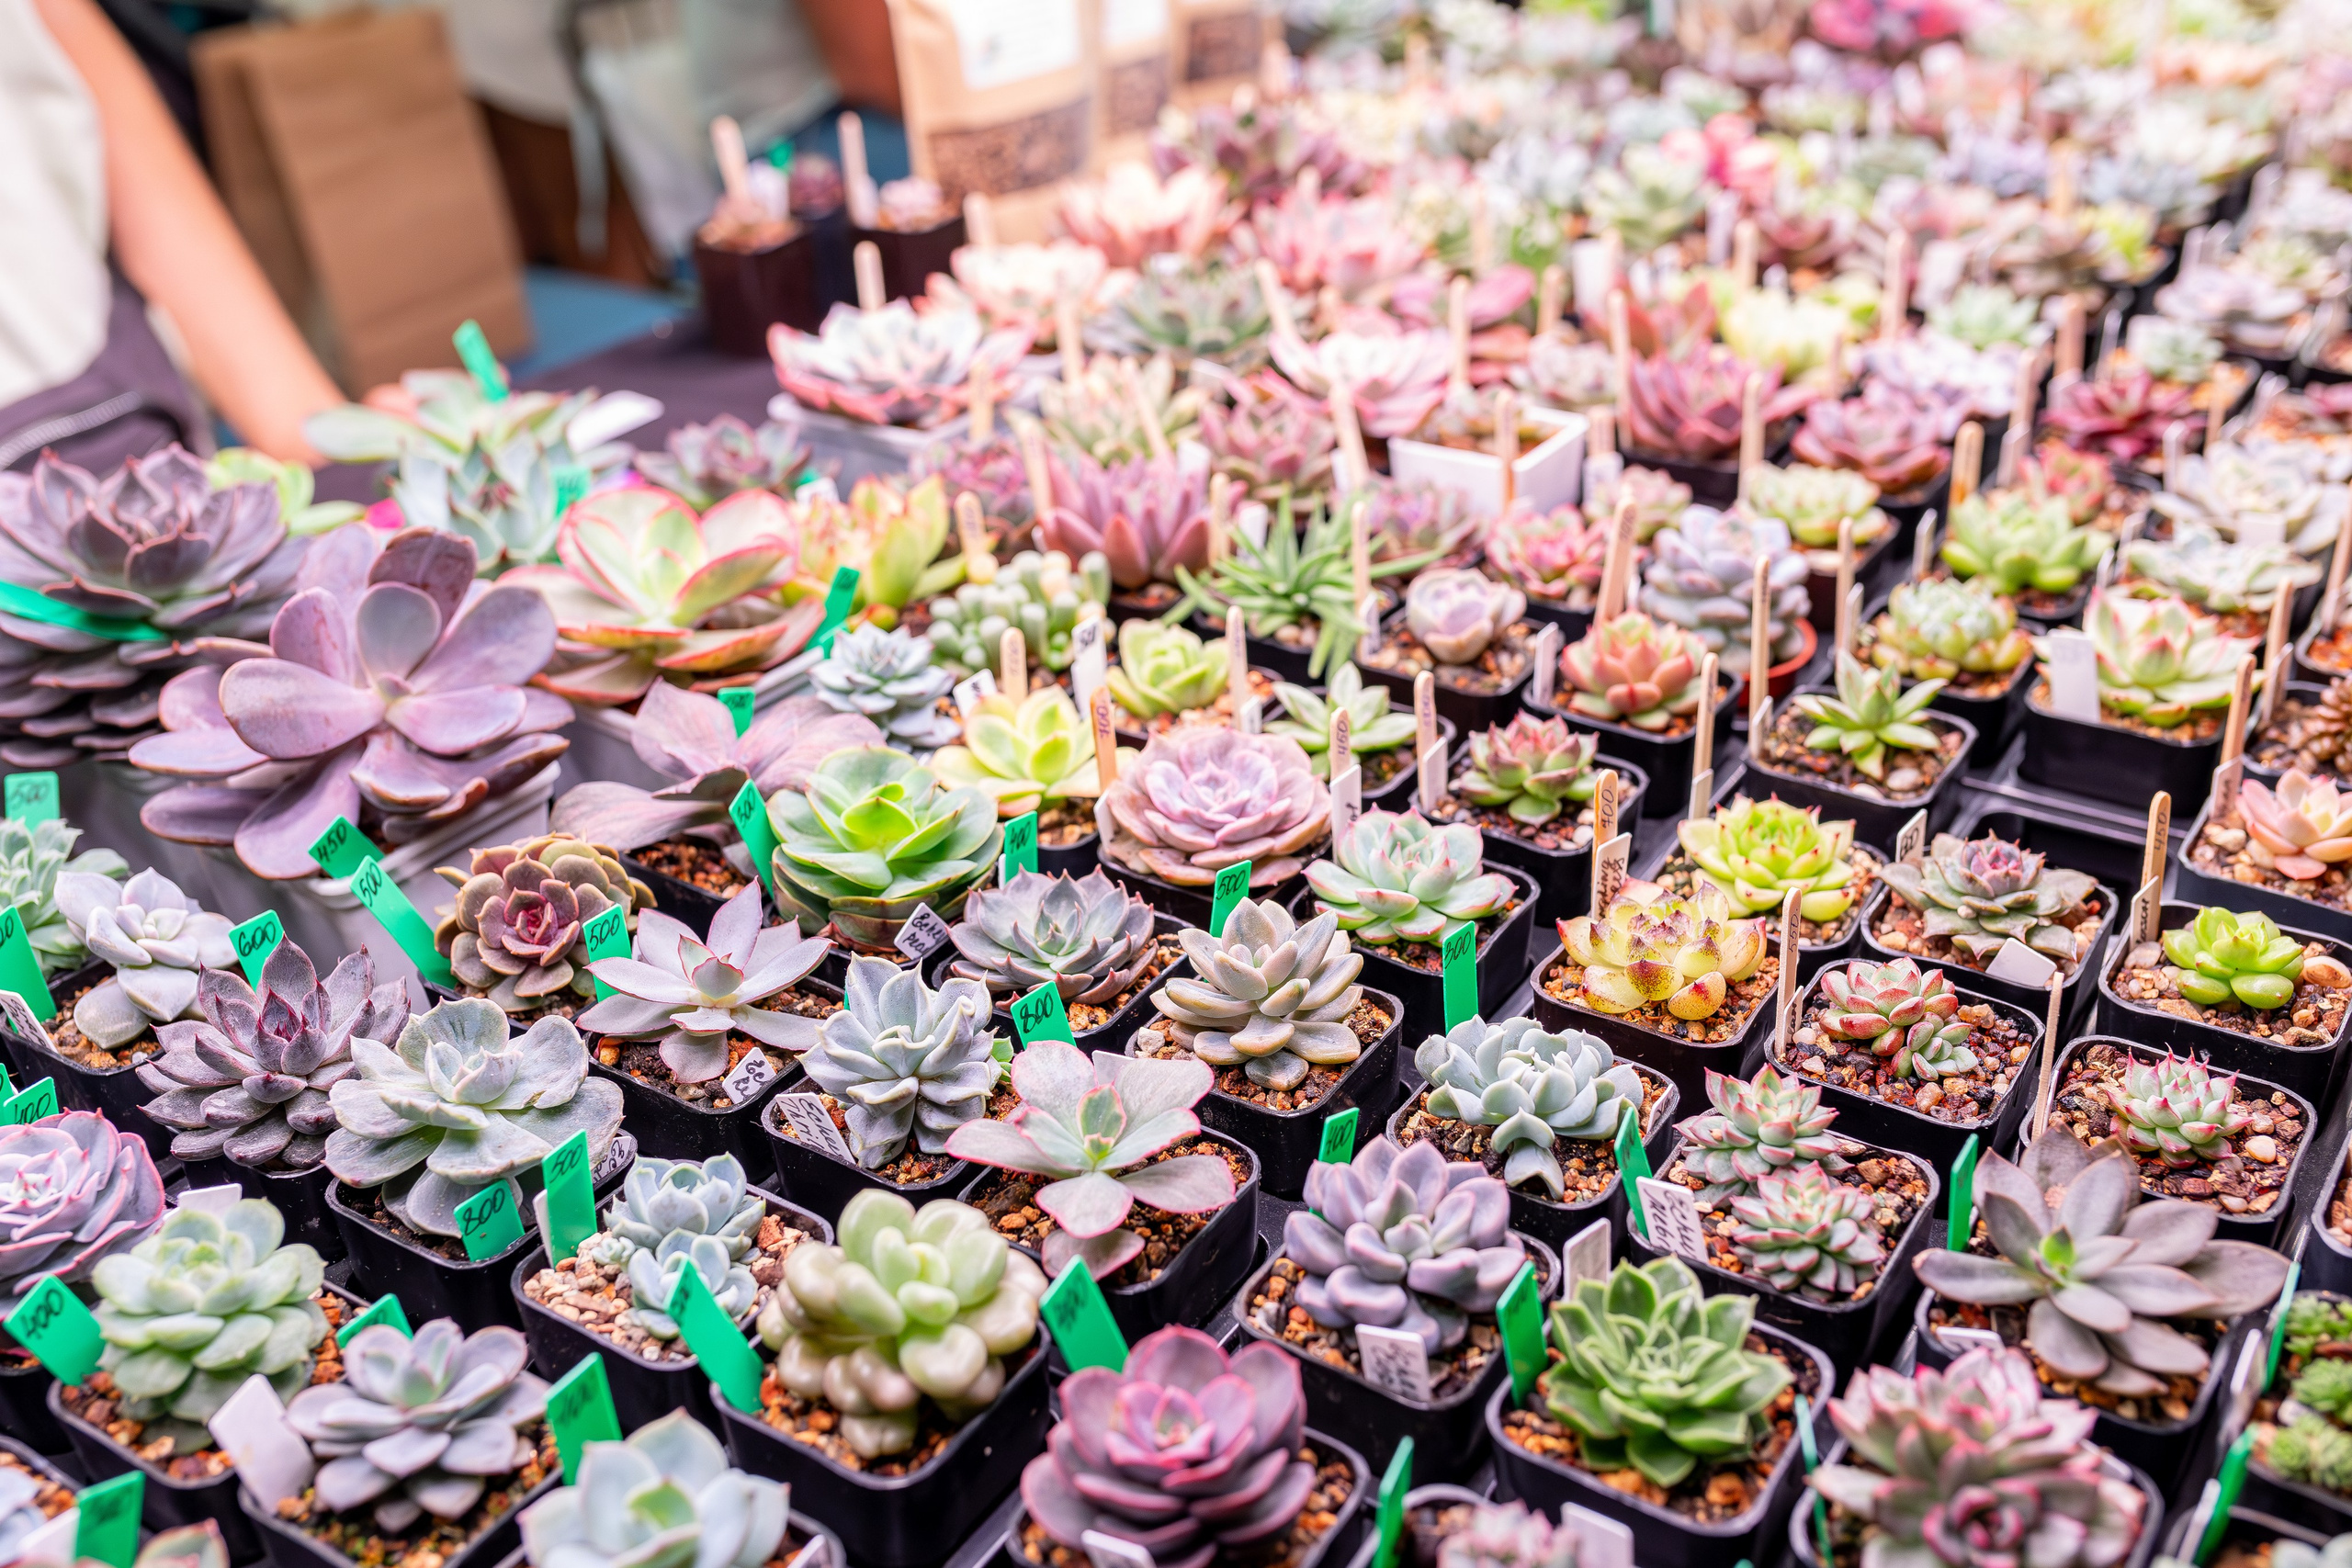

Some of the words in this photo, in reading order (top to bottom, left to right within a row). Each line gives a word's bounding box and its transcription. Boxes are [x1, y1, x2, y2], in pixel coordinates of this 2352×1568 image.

[316, 823, 347, 862] 450
[359, 863, 381, 908] 500
[1216, 870, 1246, 901] 500
[238, 920, 277, 957] 600
[589, 913, 620, 952] 500
[1444, 931, 1472, 970] 300
[1020, 991, 1054, 1033] 800
[550, 1144, 583, 1184] 500
[462, 1188, 505, 1236] 800
